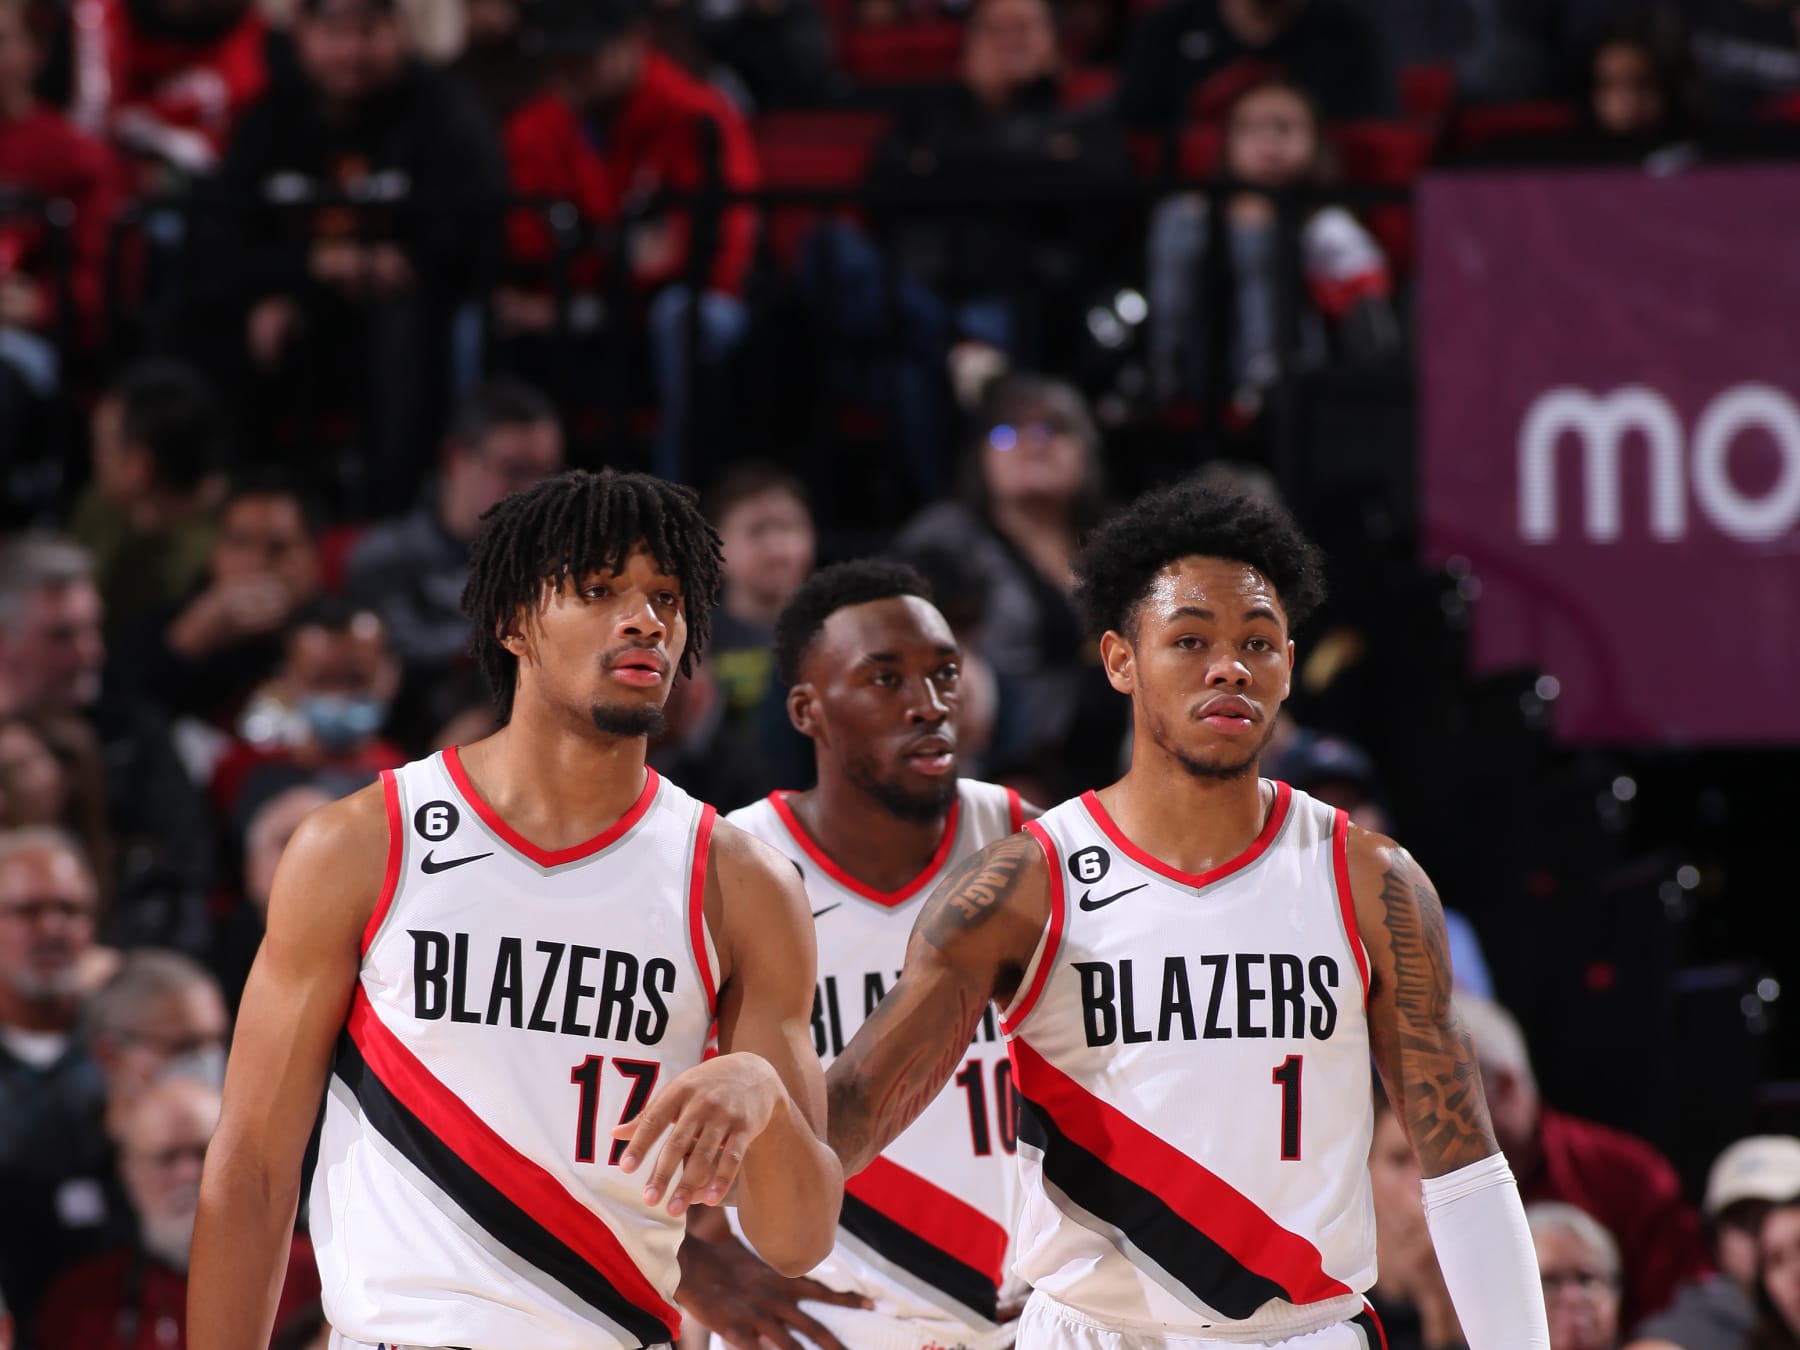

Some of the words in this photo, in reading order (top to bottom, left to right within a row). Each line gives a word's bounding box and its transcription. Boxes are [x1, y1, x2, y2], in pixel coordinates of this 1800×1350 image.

[426, 806, 449, 836] 6
[1078, 851, 1101, 880] 6
[406, 930, 677, 1047] BLAZERS
[1070, 953, 1339, 1048] BLAZERS
[570, 1054, 661, 1166] 17
[1272, 1054, 1302, 1161] 1
